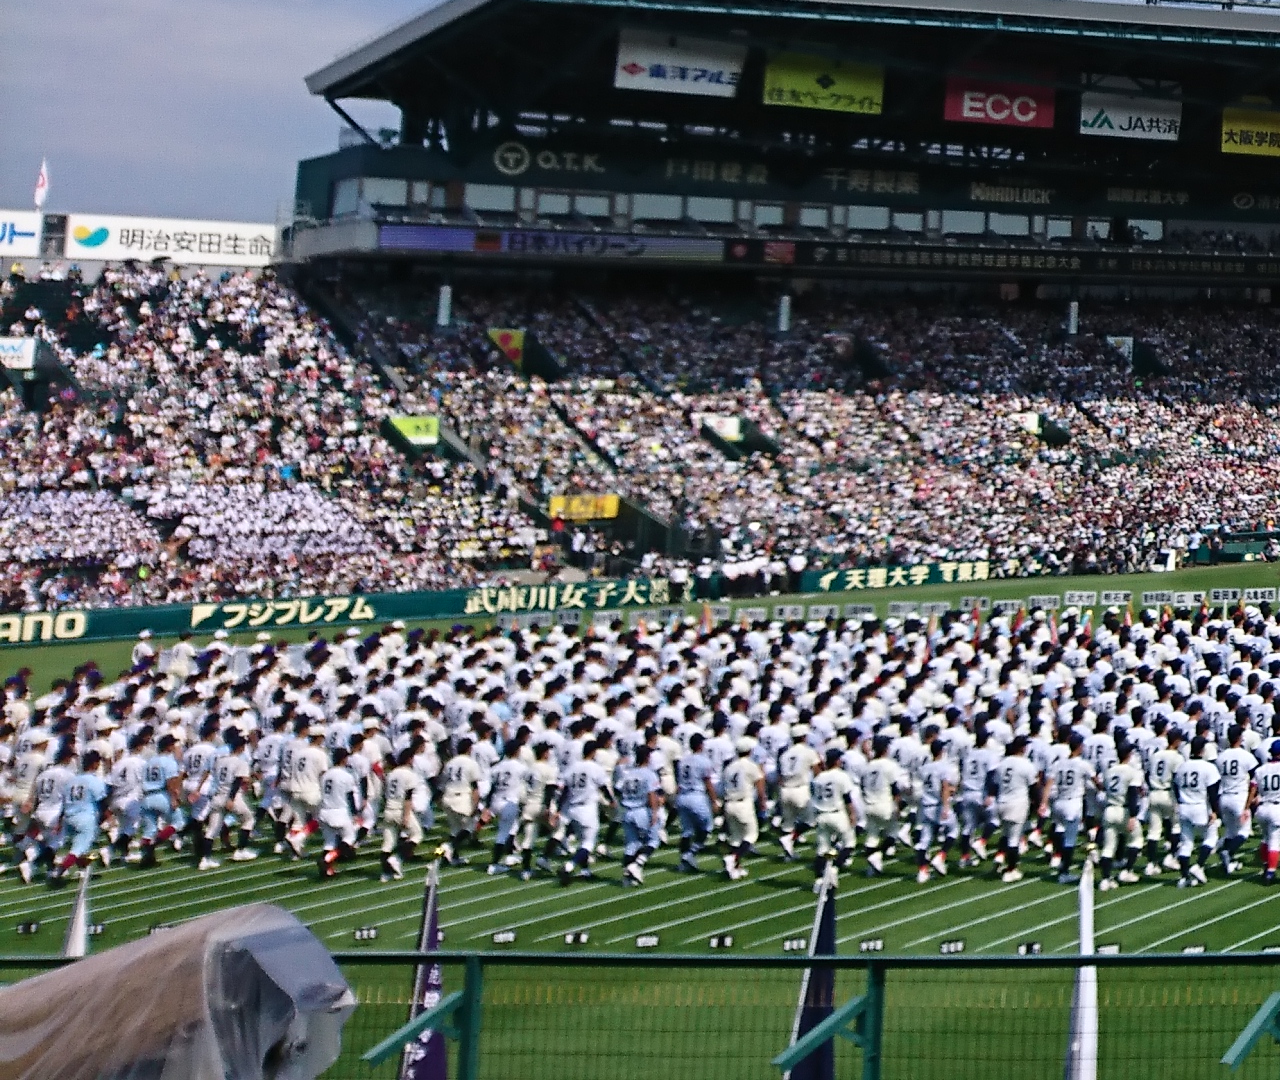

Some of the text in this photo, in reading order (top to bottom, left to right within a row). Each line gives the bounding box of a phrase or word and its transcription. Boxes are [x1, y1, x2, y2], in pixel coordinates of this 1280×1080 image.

[962, 90, 1037, 122] ECC
[1120, 115, 1179, 136] JA共済
[120, 228, 273, 257] 明治安田生命
[845, 565, 929, 590] 天理大学
[222, 596, 375, 628] フジプレアム
[1257, 714, 1264, 727] 2
[1223, 761, 1238, 775] 18
[1110, 776, 1120, 792] 2
[1183, 772, 1197, 788] 13
[1264, 775, 1280, 790] 10
